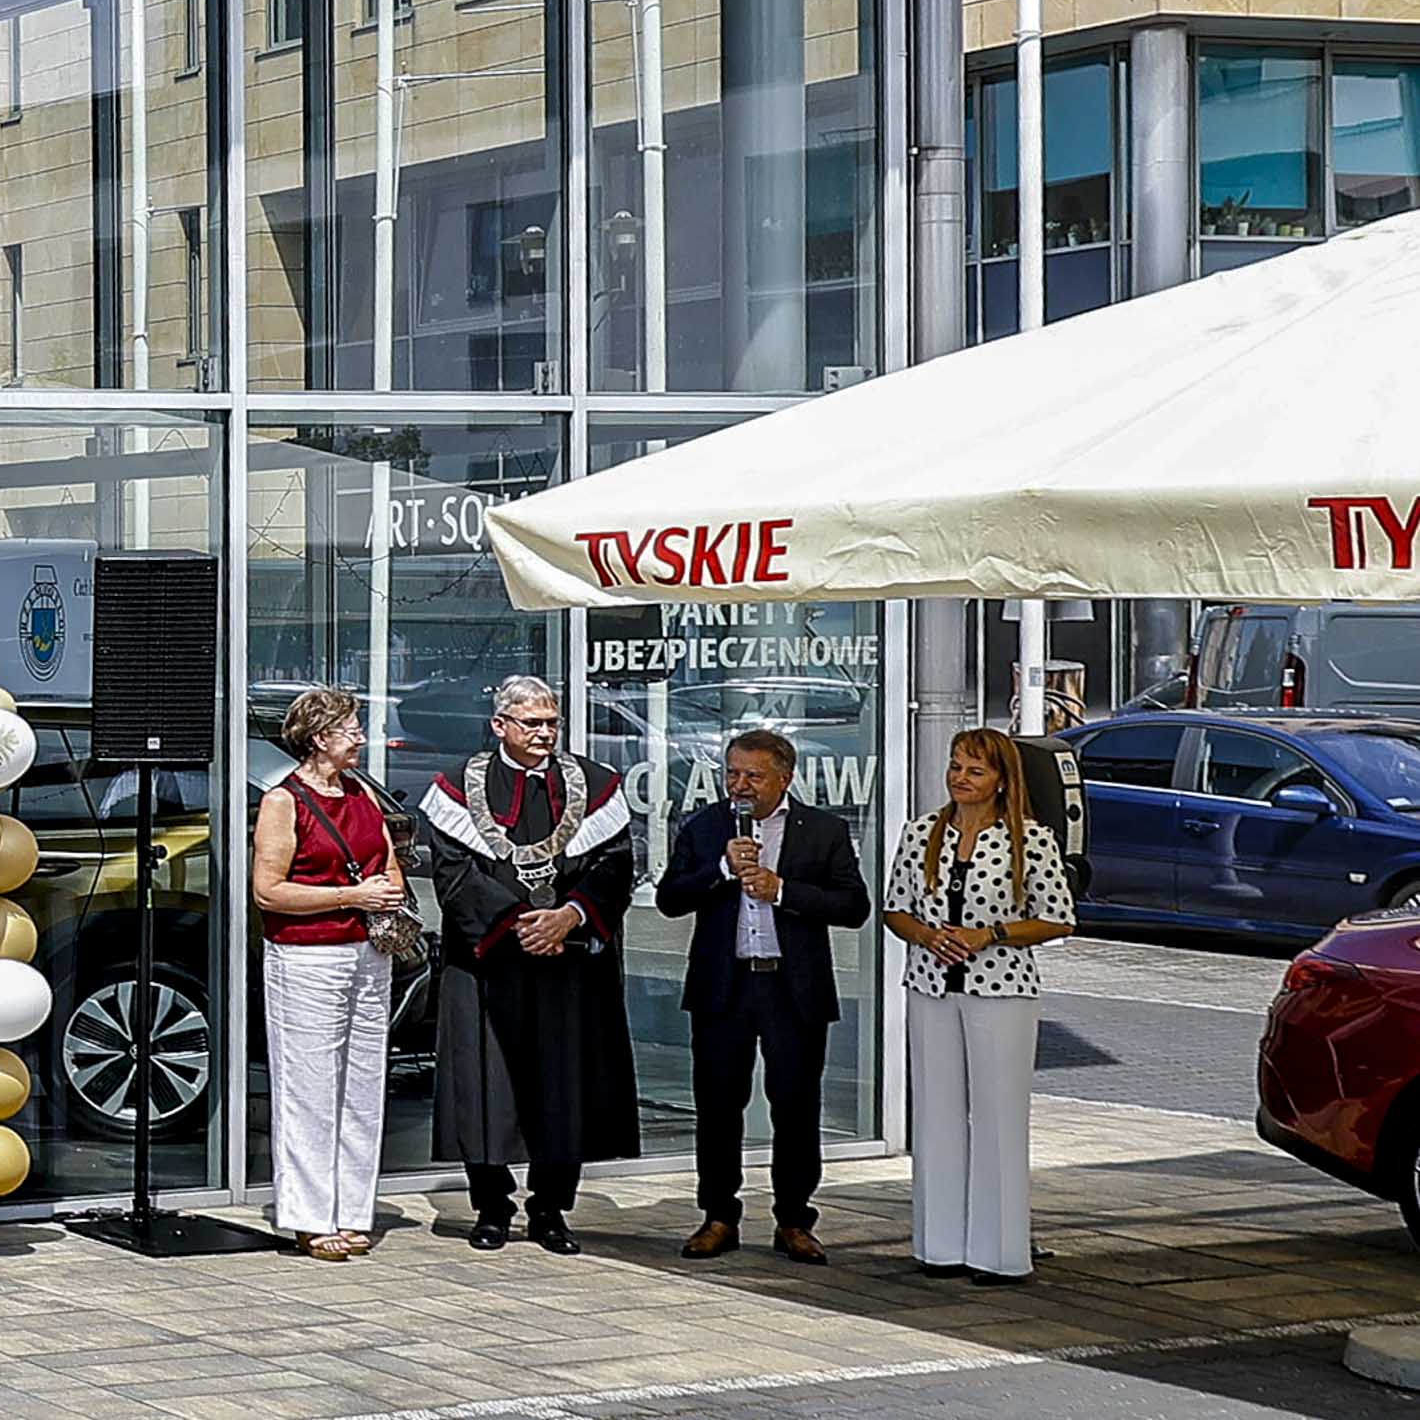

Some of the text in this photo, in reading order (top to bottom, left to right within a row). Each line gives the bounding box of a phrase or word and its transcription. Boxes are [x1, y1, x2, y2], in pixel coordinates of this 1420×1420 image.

[574, 518, 794, 588] TYSKIE
[660, 602, 798, 627] PAKIETY
[586, 635, 879, 674] UBEZPIECZENIOWE
